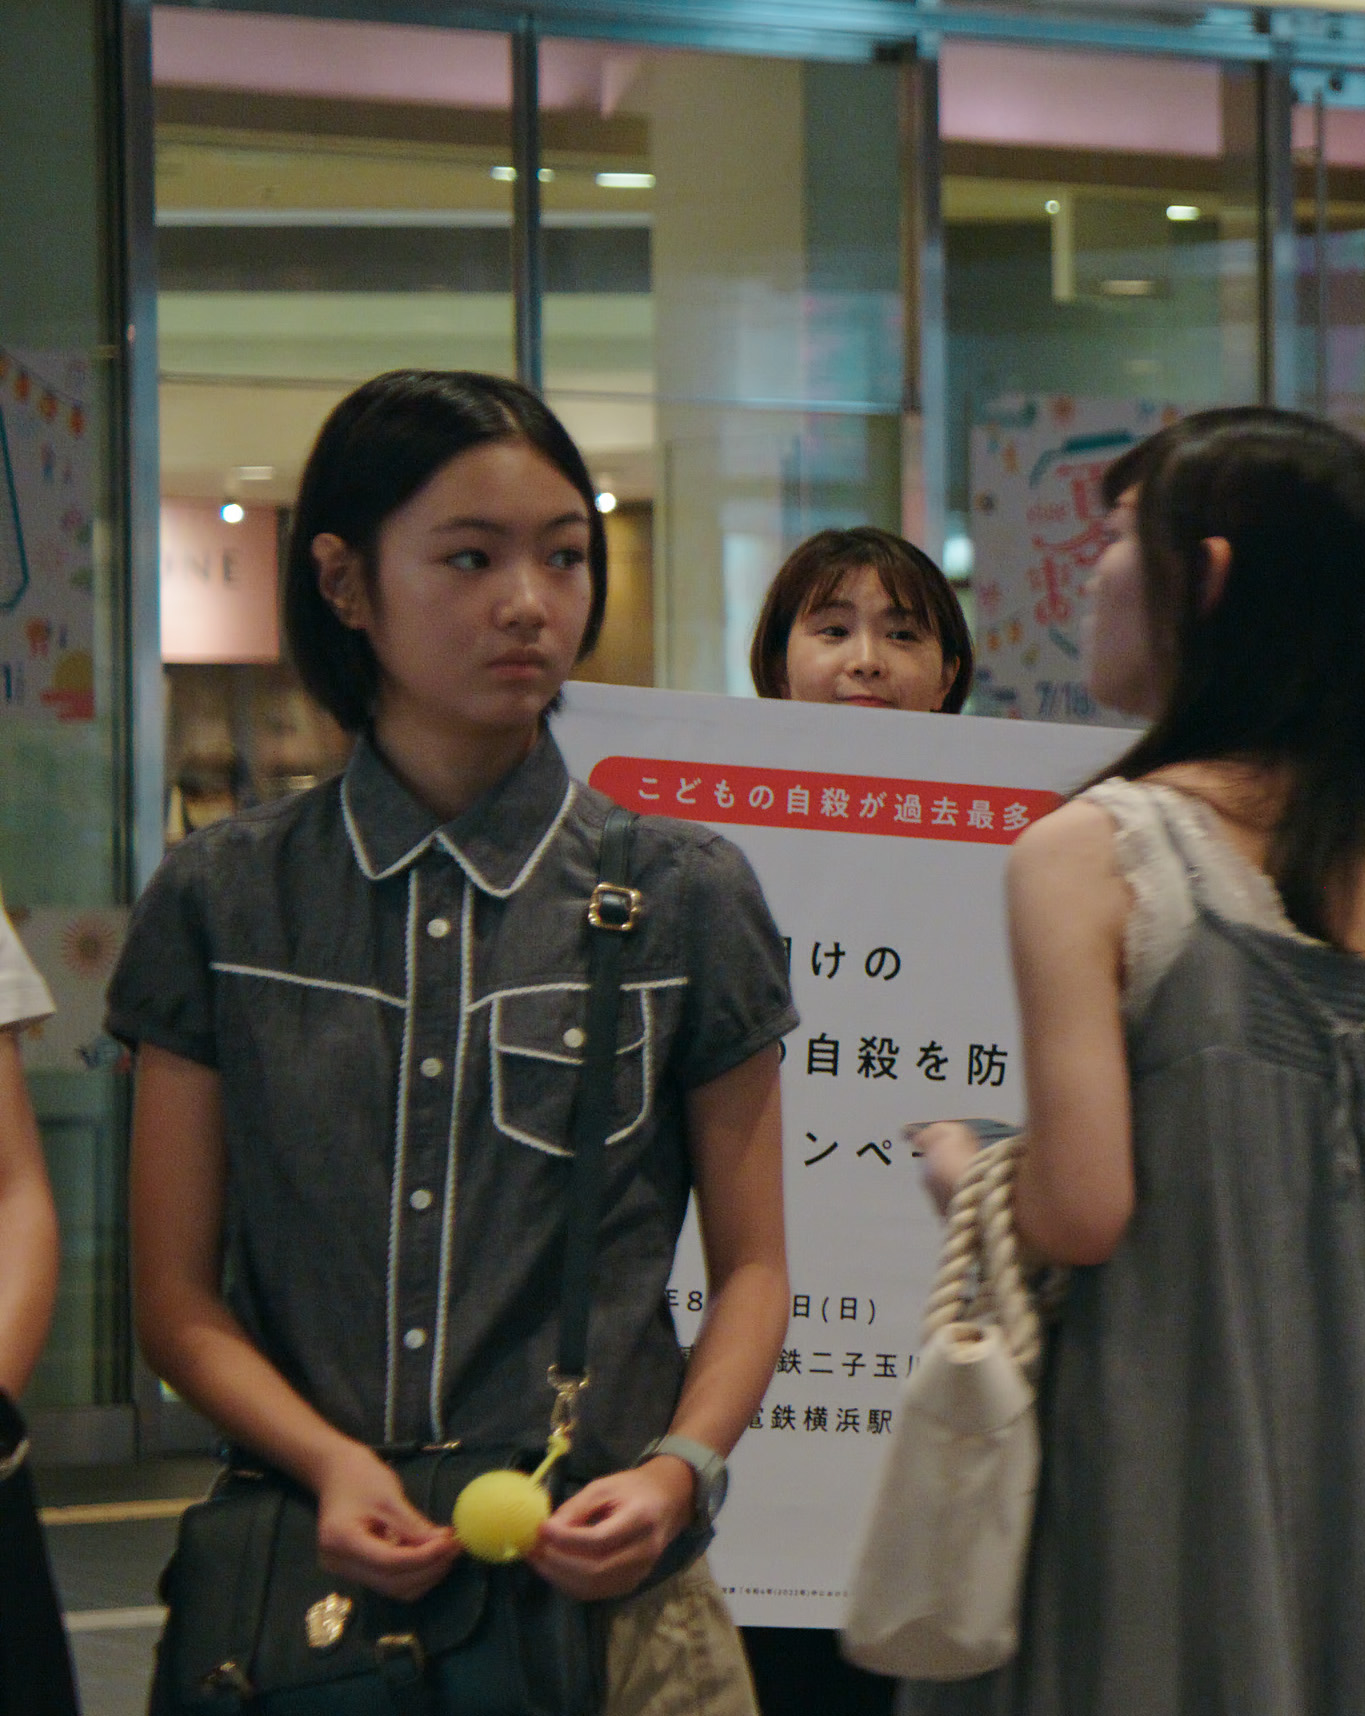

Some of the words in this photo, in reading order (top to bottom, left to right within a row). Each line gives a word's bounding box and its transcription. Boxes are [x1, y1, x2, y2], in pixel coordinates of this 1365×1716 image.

[637, 775, 1032, 832] こどもの自殺が過去最多
[782, 936, 902, 980] けの
[777, 1032, 1009, 1086] 自殺を防
